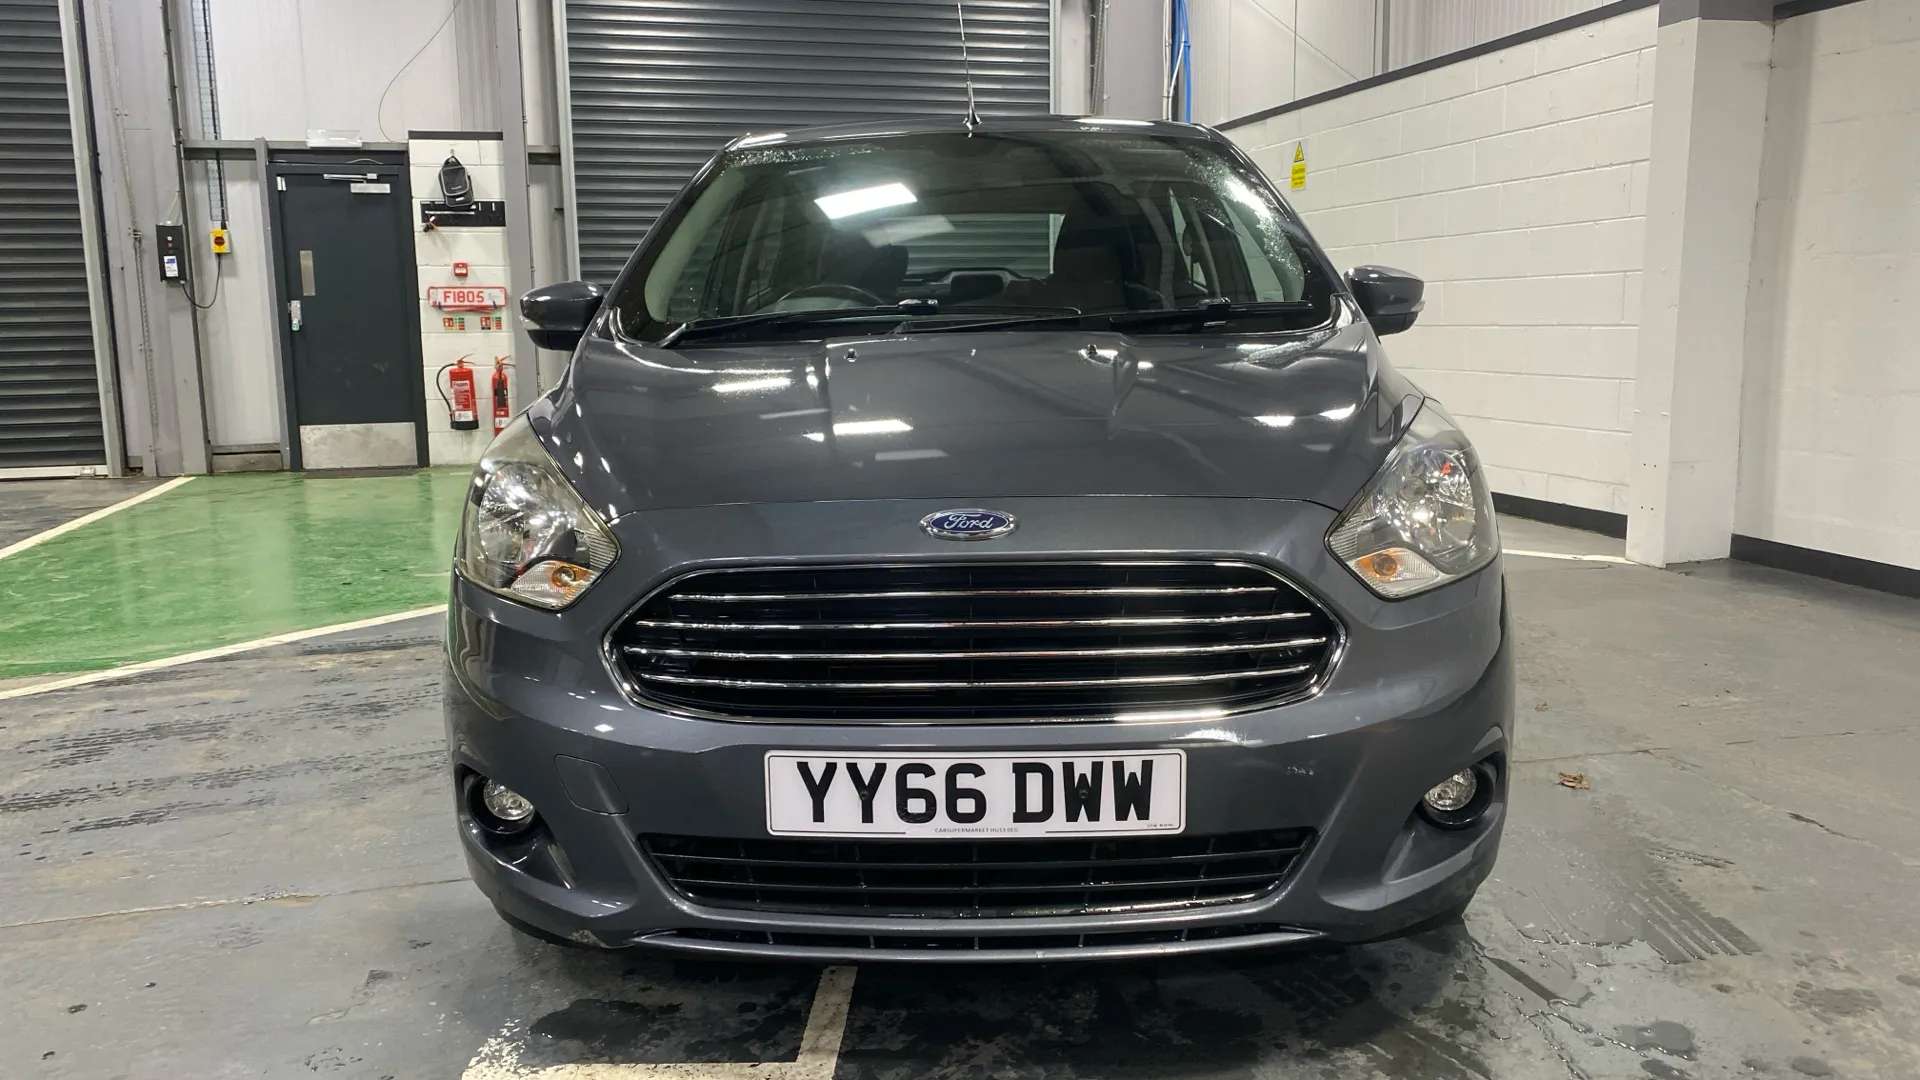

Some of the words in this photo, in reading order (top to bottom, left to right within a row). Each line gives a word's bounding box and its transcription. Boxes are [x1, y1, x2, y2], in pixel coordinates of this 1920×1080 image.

[943, 514, 994, 529] Ford
[796, 761, 987, 824] YY66
[1012, 760, 1154, 823] DWW
